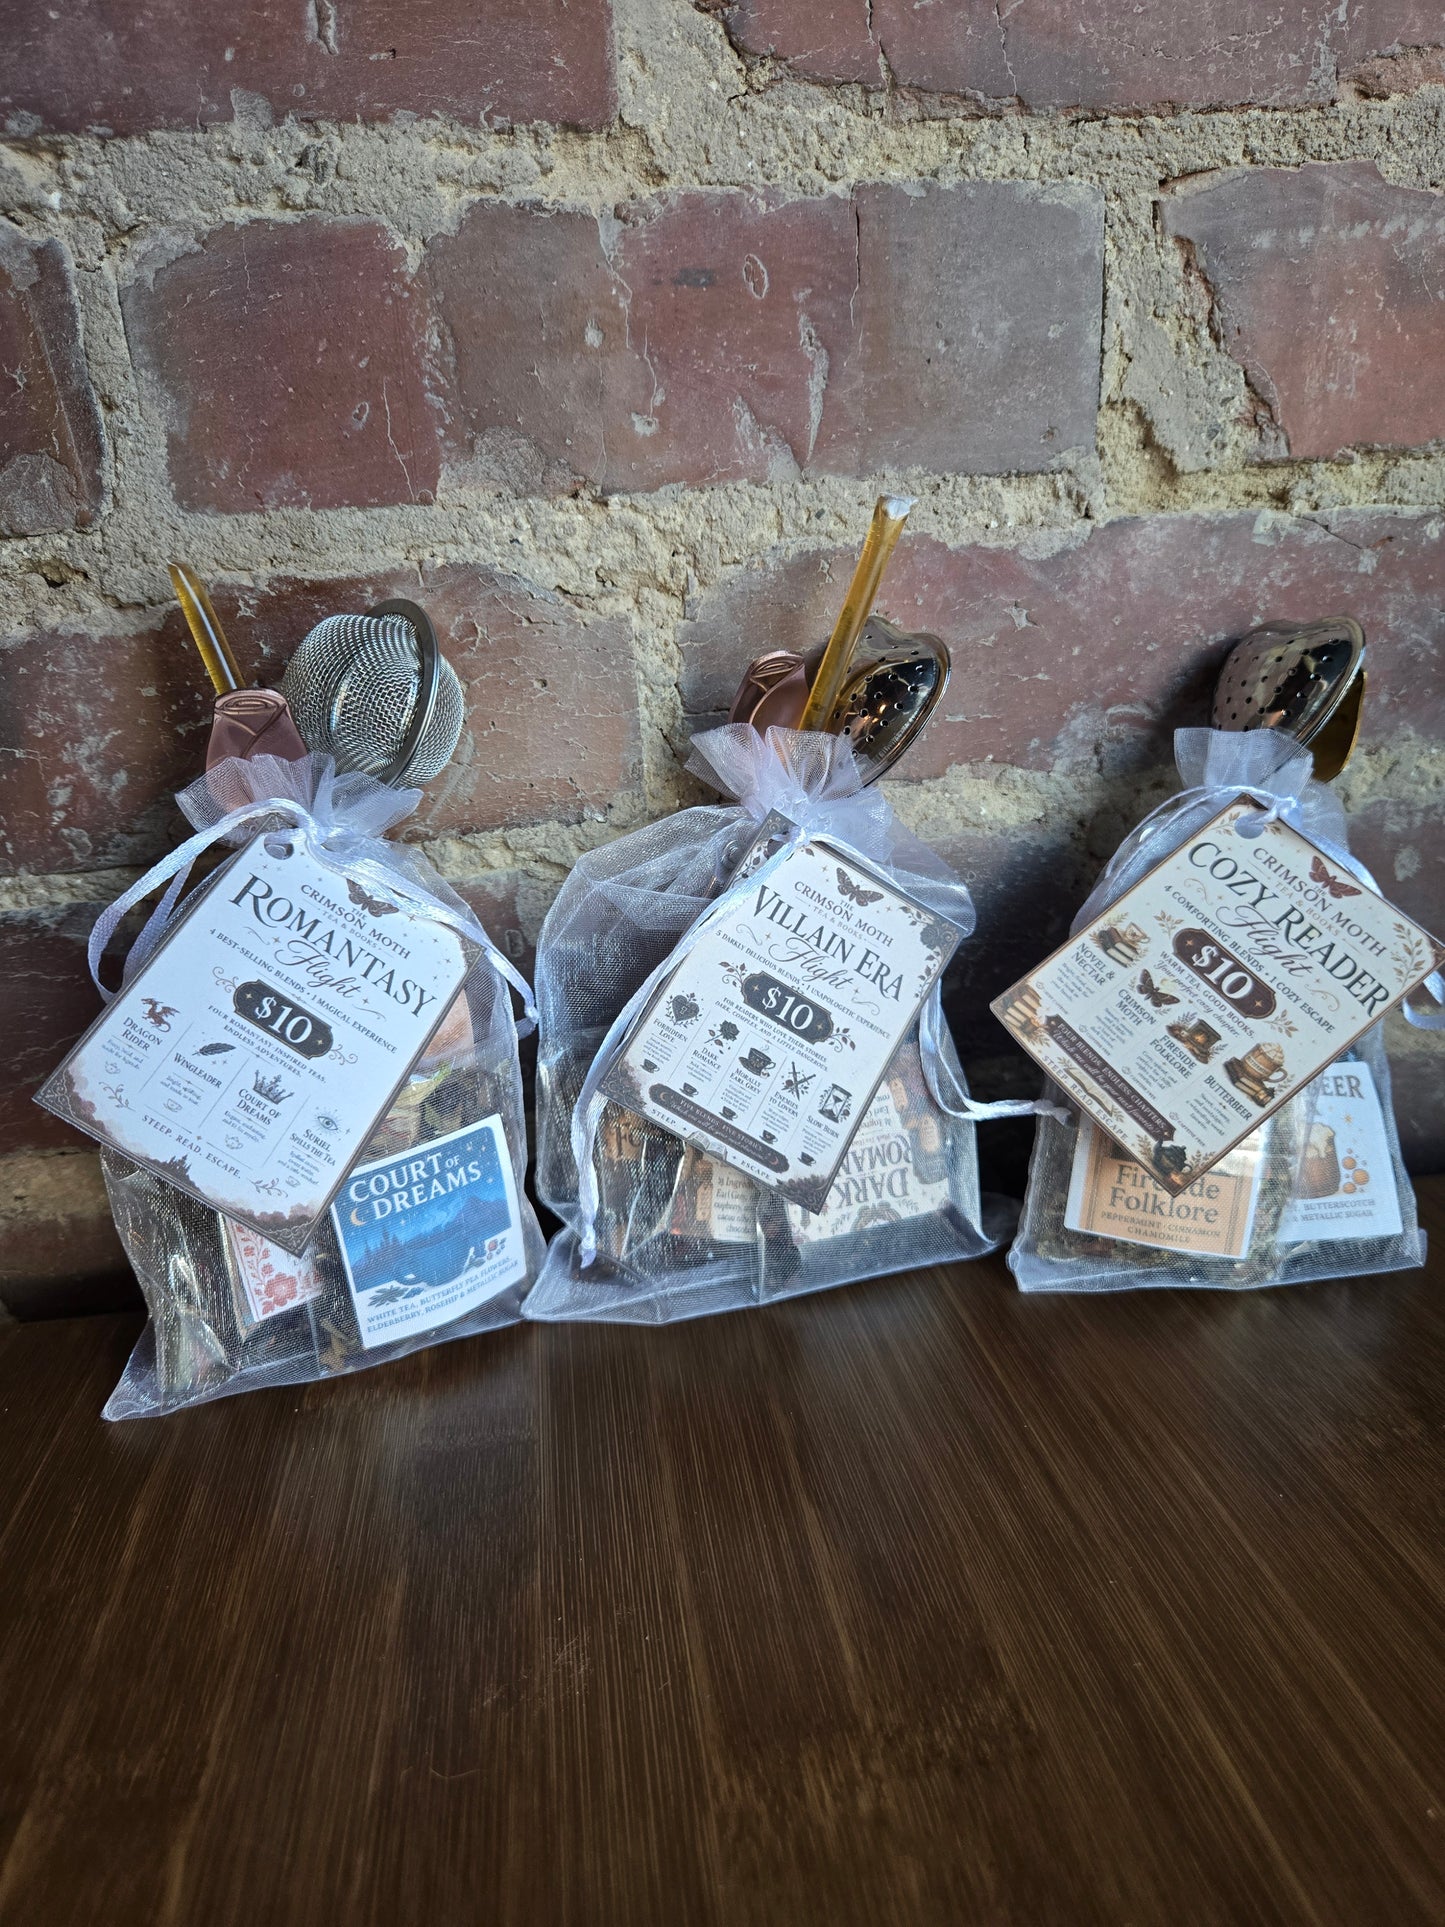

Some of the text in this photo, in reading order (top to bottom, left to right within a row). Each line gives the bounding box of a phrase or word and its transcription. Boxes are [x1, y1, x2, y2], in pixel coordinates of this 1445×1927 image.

[794, 881, 893, 947] CRIMSON MOTH
[1253, 847, 1387, 957] CRIMSON MOTH
[1275, 881, 1294, 899] TEA
[1306, 907, 1340, 936] BOOKS
[301, 884, 411, 959] CRIMSON MOTH
[322, 910, 338, 924] TEA
[349, 928, 377, 948] BOOKS
[813, 905, 828, 919] TEA
[837, 921, 863, 940] BOOKS
[1188, 842, 1390, 1017] COZY READER
[229, 872, 436, 1017] ROMANTASY
[722, 933, 744, 951] DARKLY
[745, 948, 777, 970] DELICIOUS
[777, 967, 800, 985] BLENDS
[753, 884, 904, 1002] VILLAIN ERA
[1215, 905, 1313, 977] Flight
[274, 939, 361, 998] Flight
[768, 937, 854, 990] Flight
[1072, 952, 1106, 986] NECTAR
[1077, 943, 1115, 981] NOVEL &
[1172, 891, 1230, 942] COMFORTING
[1229, 941, 1264, 972] BLENDS
[1276, 982, 1302, 1003] COZY
[1300, 1002, 1335, 1033] ESCAPE
[1192, 945, 1253, 999] $10
[217, 932, 274, 972] BEST-SELLING
[274, 970, 306, 993] BLENDS
[317, 998, 351, 1024] MAGICAL
[352, 1021, 397, 1054] EXPERIENCE
[1153, 960, 1175, 978] Your
[1171, 978, 1198, 998] perfect
[1196, 998, 1214, 1014] cozy
[1160, 951, 1185, 974] WARM
[1202, 990, 1227, 1012] GOOD
[1226, 1011, 1255, 1039] BOOKS.
[208, 1005, 229, 1020] FOUR
[255, 997, 312, 1043] $10
[723, 997, 735, 1007] FOR
[735, 1004, 759, 1021] READERS
[772, 1027, 787, 1039] LOVE
[788, 1036, 805, 1049] THEIR
[762, 986, 814, 1030] $10
[1116, 1000, 1143, 1026] MOTH
[1118, 989, 1156, 1025] CRIMSON
[122, 1029, 150, 1051] RIDER
[123, 1017, 163, 1045] DRAGON
[223, 1024, 254, 1046] ENDLESS
[653, 1018, 688, 1042] FORBIDDEN
[659, 1029, 675, 1043] LOVE
[759, 1028, 772, 1037] AND
[174, 1053, 222, 1088] WINGLEADER
[692, 1049, 721, 1070] ROMANCE
[701, 1047, 718, 1061] DARK
[1057, 1023, 1077, 1042] FOUR
[1102, 1067, 1132, 1095] ENDLESS
[1150, 1039, 1191, 1079] FOLKLORE
[1160, 1035, 1197, 1070] FIRESIDE
[729, 1072, 744, 1085] EARL
[745, 1082, 761, 1094] GREY
[733, 1068, 761, 1088] MORALLY
[237, 1099, 271, 1125] DREAMS
[238, 1088, 282, 1119] COURT OF
[769, 1096, 798, 1117] TO LOVERS
[774, 1091, 798, 1110] ENEMIES
[1204, 1075, 1252, 1120] BUTTERBEER
[303, 1129, 331, 1152] SURIEL
[806, 1115, 823, 1129] SLOW
[823, 1124, 839, 1139] BURN
[142, 1115, 240, 1179] STEEP. READ. ESCAPE.
[289, 1132, 336, 1166] SPILLS THE TEA
[350, 1152, 442, 1203] COURT
[445, 1155, 460, 1169] OF
[372, 1161, 482, 1220] DREAMS
[833, 1167, 910, 1210] DARK
[1116, 1164, 1220, 1200] Firde
[1108, 1186, 1219, 1224] Folklore
[1301, 1211, 1344, 1223] METALLIC
[1303, 1199, 1376, 1212] BUTTERSCOTCH
[1101, 1210, 1221, 1239] PEPPERMINT CINNAMON
[1127, 1226, 1191, 1243] CHAMOMILE
[367, 1308, 397, 1324] WHITE
[419, 1283, 464, 1306] BUTTERFLY
[465, 1275, 480, 1287] PEA
[425, 1295, 460, 1313] ROSEHIP
[466, 1276, 499, 1296] METALLIC
[498, 1259, 520, 1277] SUGAR
